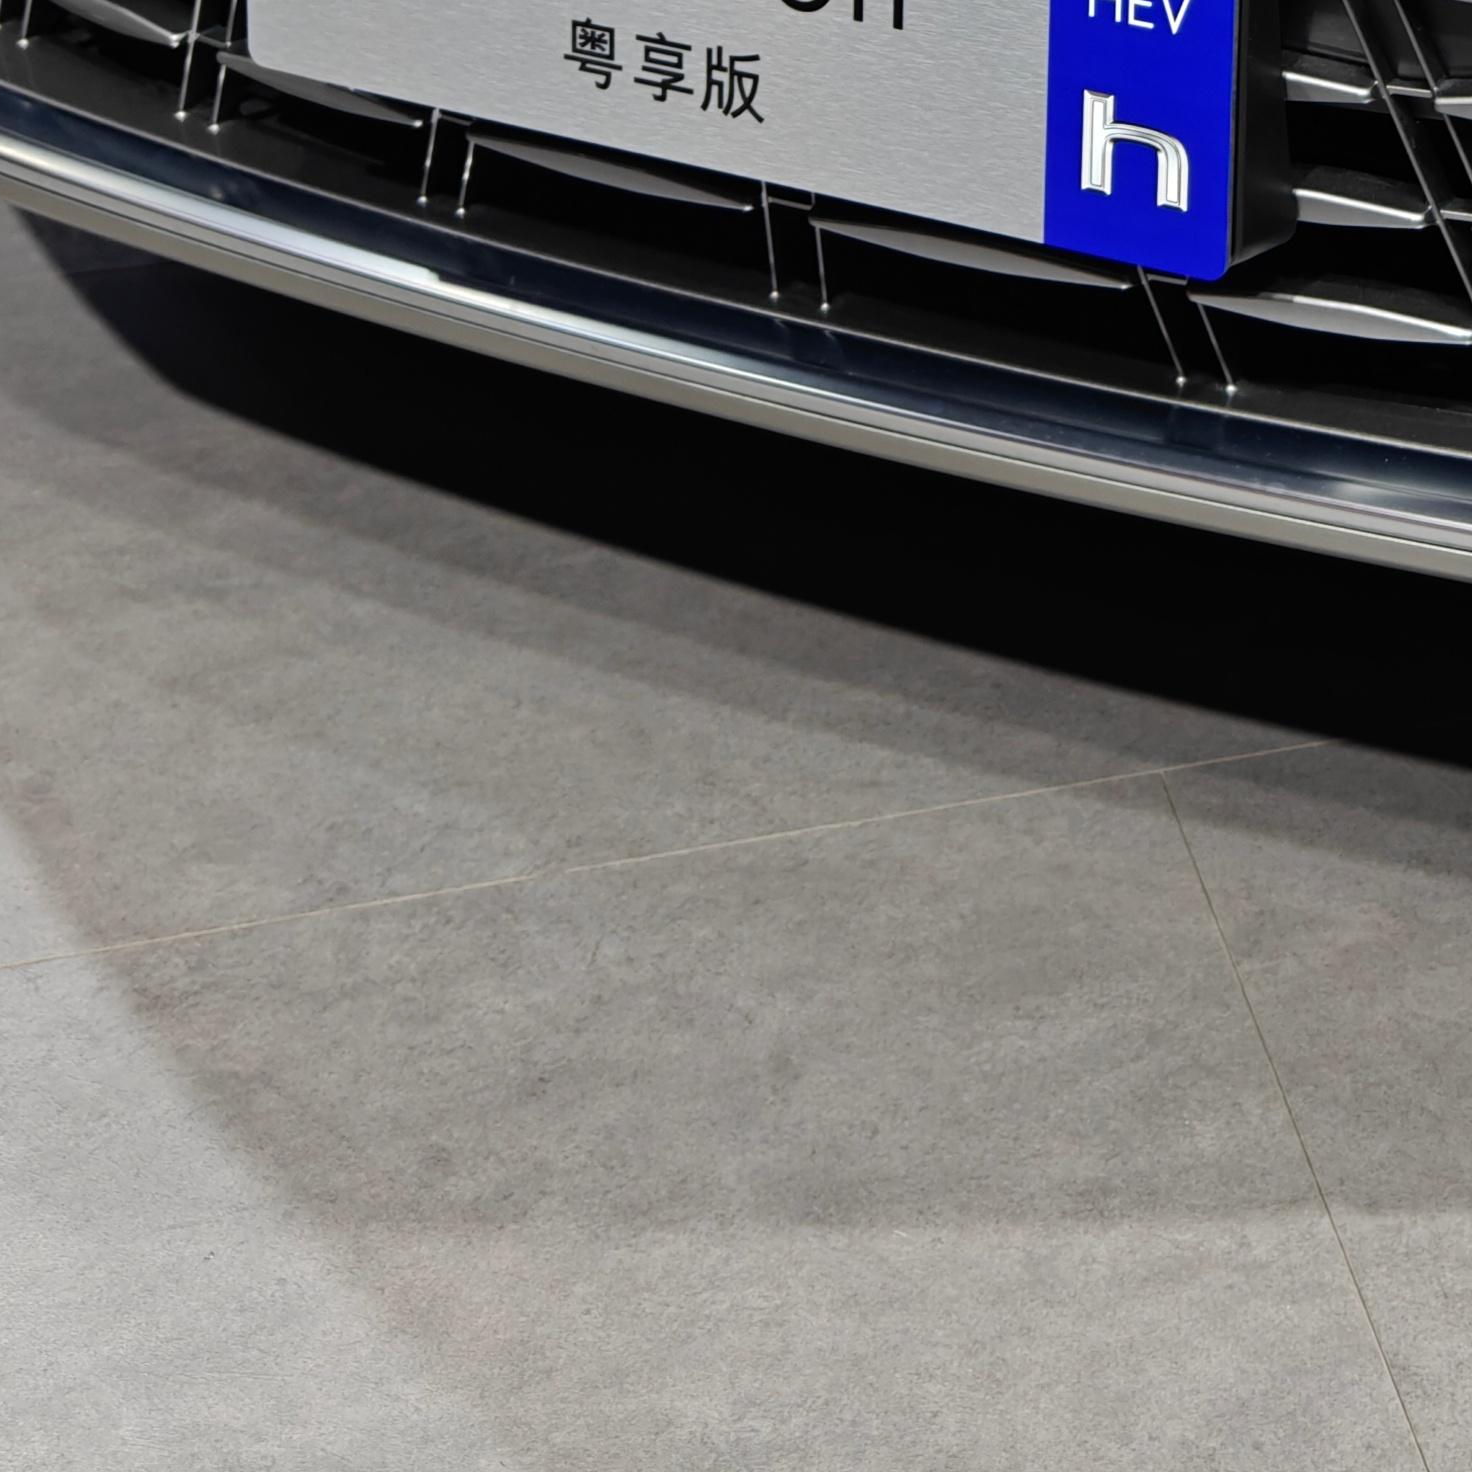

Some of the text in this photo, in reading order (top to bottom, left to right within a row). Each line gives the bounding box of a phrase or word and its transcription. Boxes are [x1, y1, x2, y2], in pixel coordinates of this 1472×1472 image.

[563, 16, 767, 125] 粤享版
[1079, 88, 1191, 214] h
